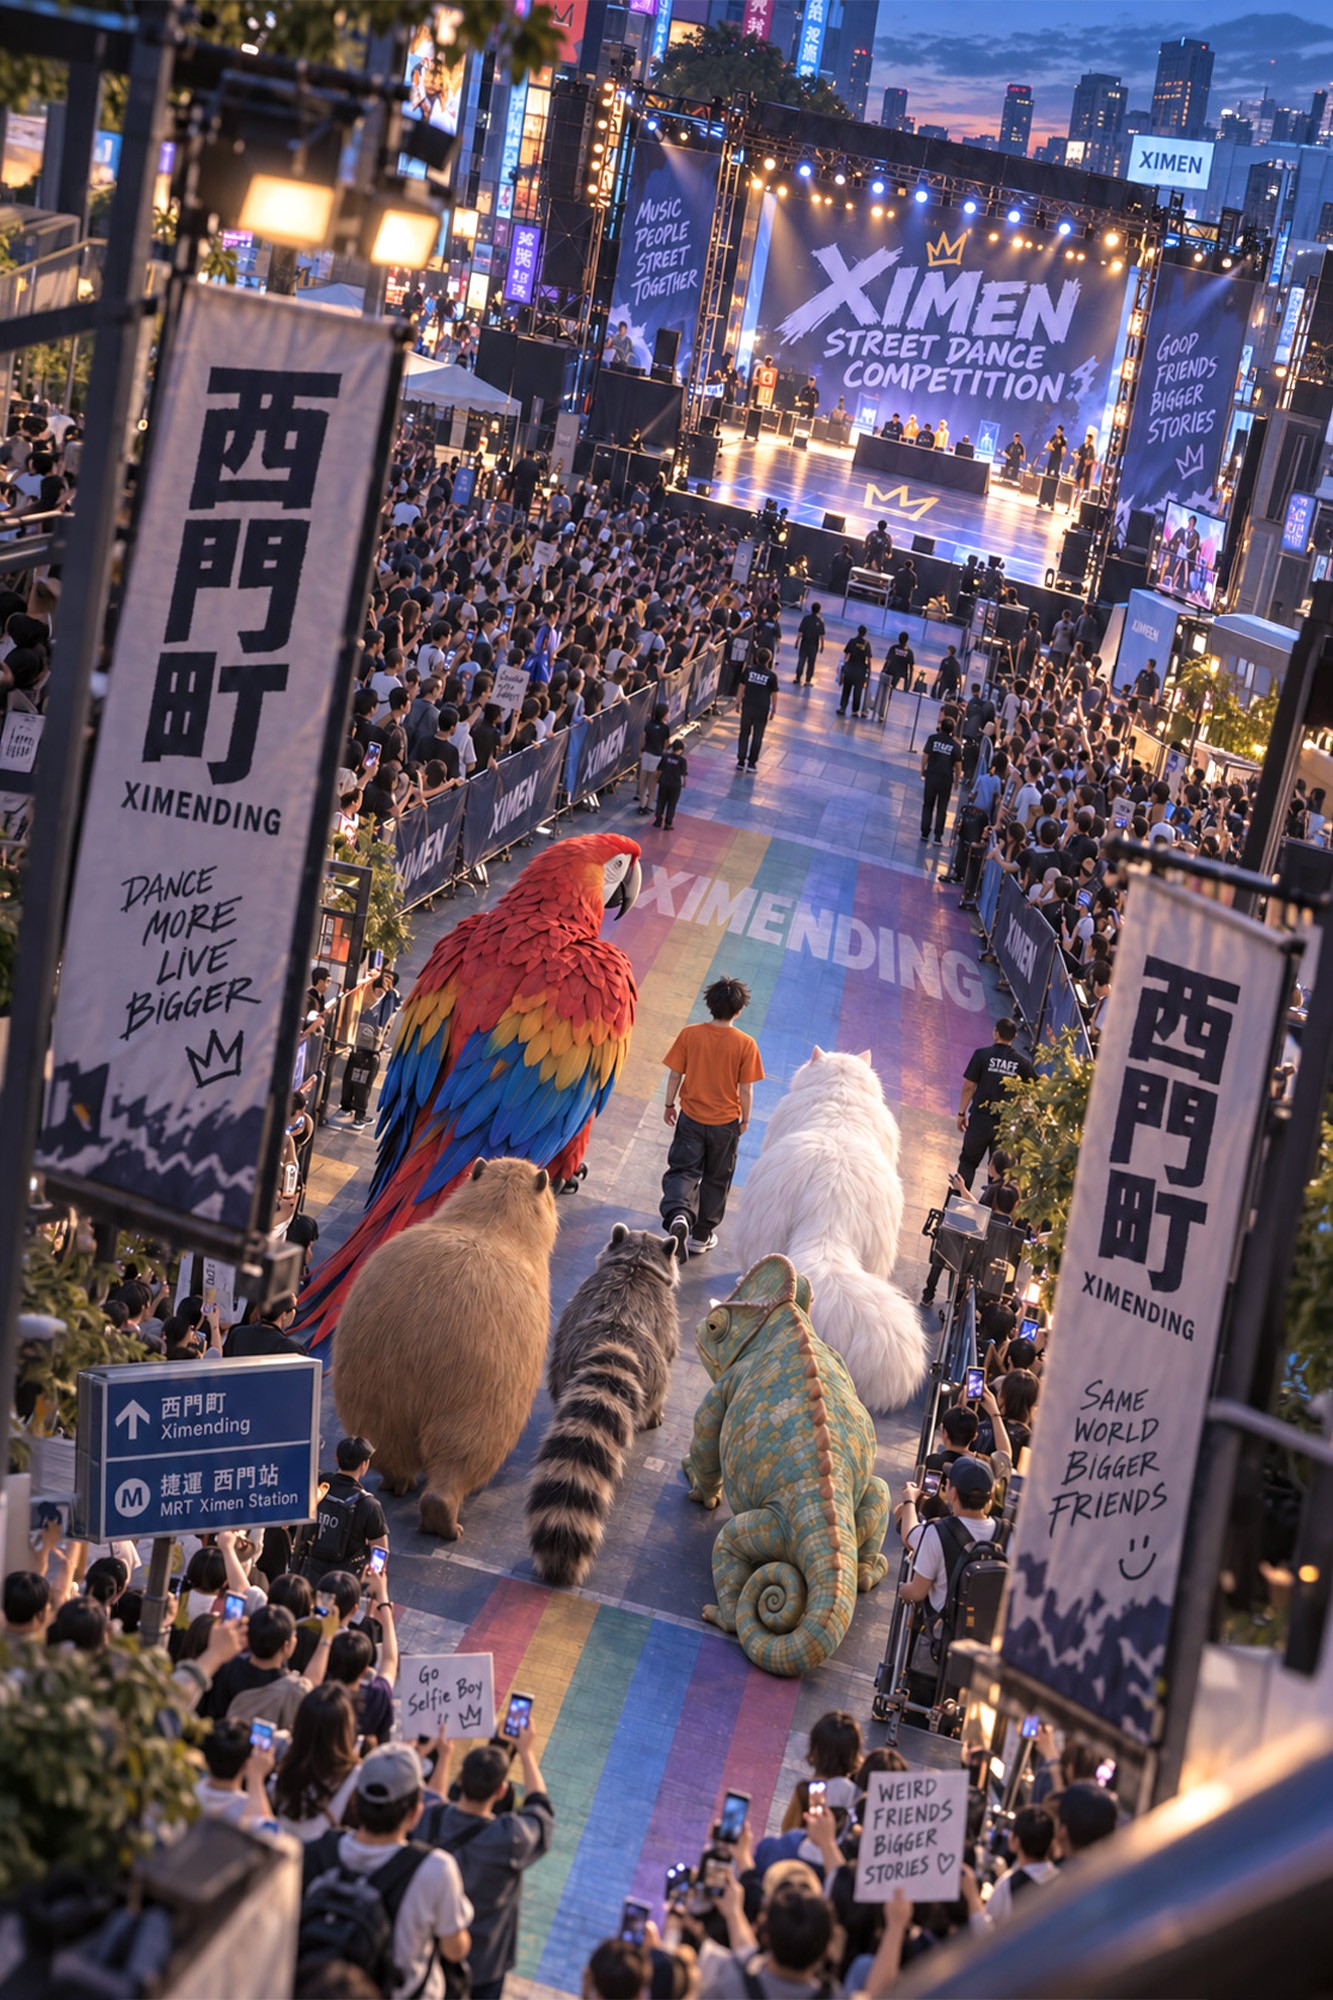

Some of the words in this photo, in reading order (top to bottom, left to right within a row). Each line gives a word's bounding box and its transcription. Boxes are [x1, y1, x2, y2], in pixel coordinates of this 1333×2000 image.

[1139, 150, 1203, 174] XIMEN
[634, 220, 690, 254] PEOPLE
[635, 244, 692, 278] STREET
[630, 269, 698, 307] TOGETHER
[774, 242, 1083, 345] XIMEN
[823, 328, 940, 359] STREET
[946, 337, 1046, 370] DANCE
[843, 360, 1065, 404] COMPETITION
[1154, 356, 1218, 392] FRIENDS
[1149, 383, 1204, 417] BIGGER
[1147, 409, 1217, 444] STORIES
[141, 366, 343, 785] 西門町
[582, 720, 628, 784] XIMEN
[121, 781, 282, 836] XIMENDING
[488, 770, 539, 840] XIMEN
[120, 866, 218, 912] DANCE
[142, 896, 243, 946] MORE
[632, 864, 987, 1013] XIMENDING
[988, 1057, 1019, 1073] STAFF
[1098, 954, 1241, 1293] 西門町
[1081, 1271, 1195, 1341] XIMENDING
[161, 1392, 226, 1420] 西門町
[1080, 1379, 1149, 1413] SAME
[161, 1418, 251, 1441] Ximending
[1074, 1416, 1160, 1446] WORLD
[160, 1471, 203, 1498] 捷運
[213, 1463, 279, 1493] 西門站
[160, 1499, 194, 1517] MRT
[199, 1497, 244, 1513] Ximen
[249, 1491, 298, 1508] Station
[1048, 1482, 1168, 1539] FRIENDS
[407, 1687, 452, 1717] Selfie
[456, 1677, 483, 1701] Boy
[879, 1778, 938, 1803] WEIRD
[873, 1798, 954, 1831] FRIENDS
[864, 1855, 930, 1886] STORIES
